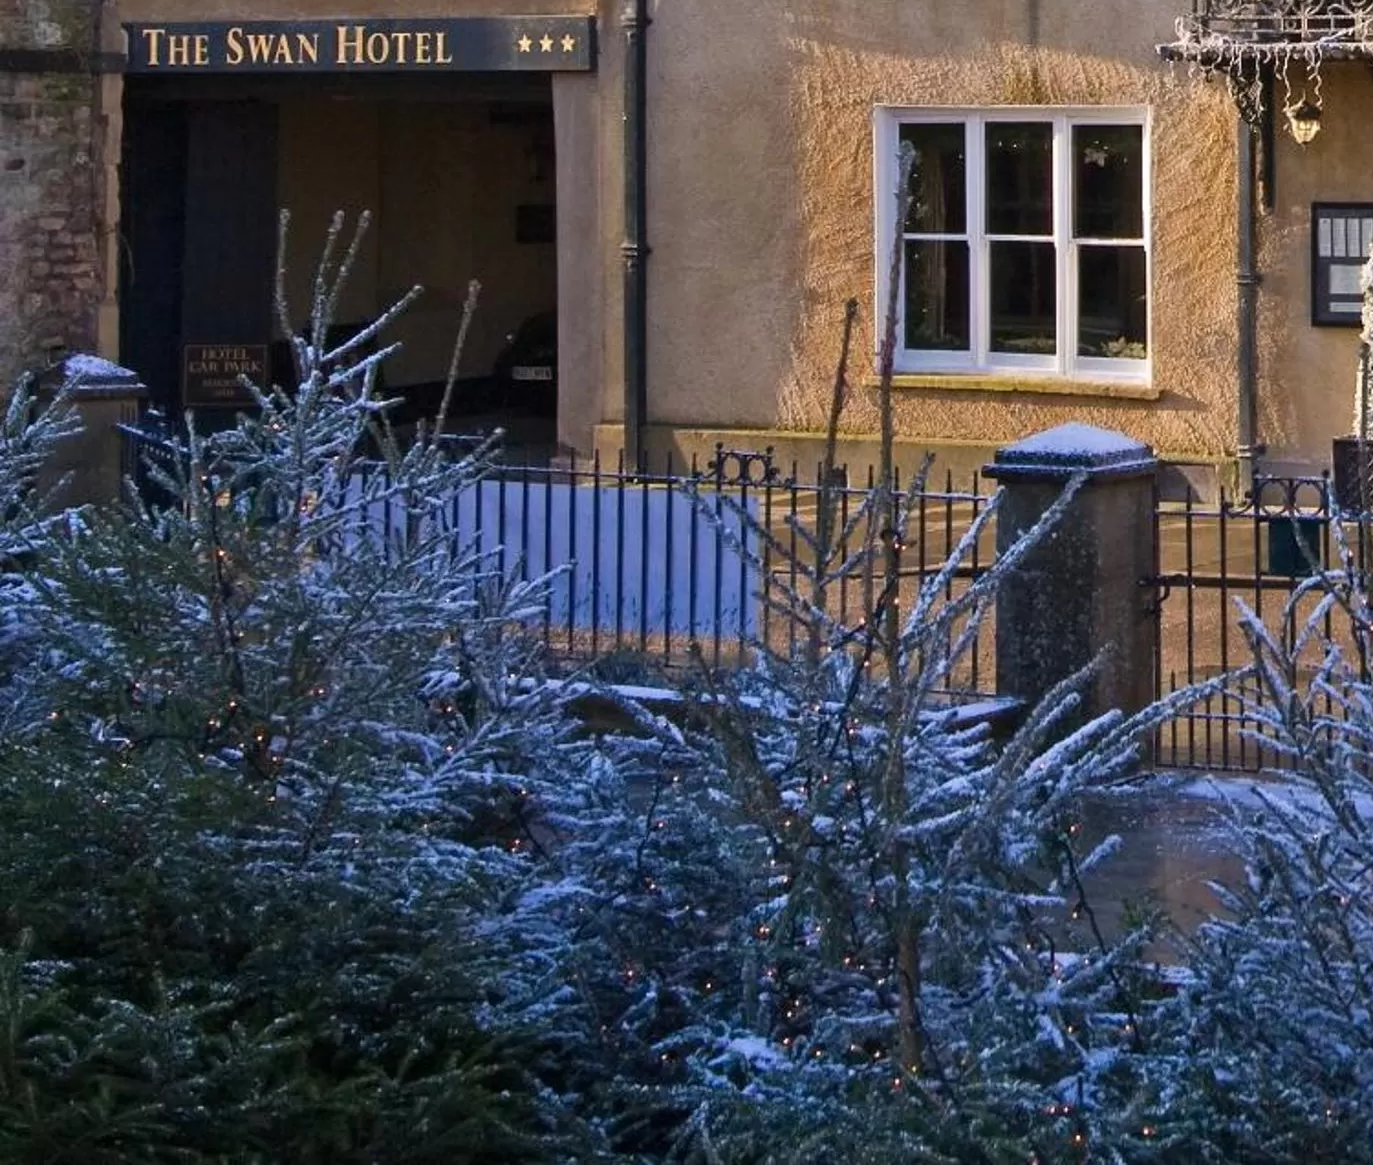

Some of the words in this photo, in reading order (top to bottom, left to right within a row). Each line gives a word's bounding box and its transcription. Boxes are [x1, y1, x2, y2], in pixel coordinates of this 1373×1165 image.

[142, 29, 210, 66] THE
[226, 27, 319, 65] SWAN
[335, 25, 453, 64] HOTEL
[201, 347, 250, 360] HOTEL
